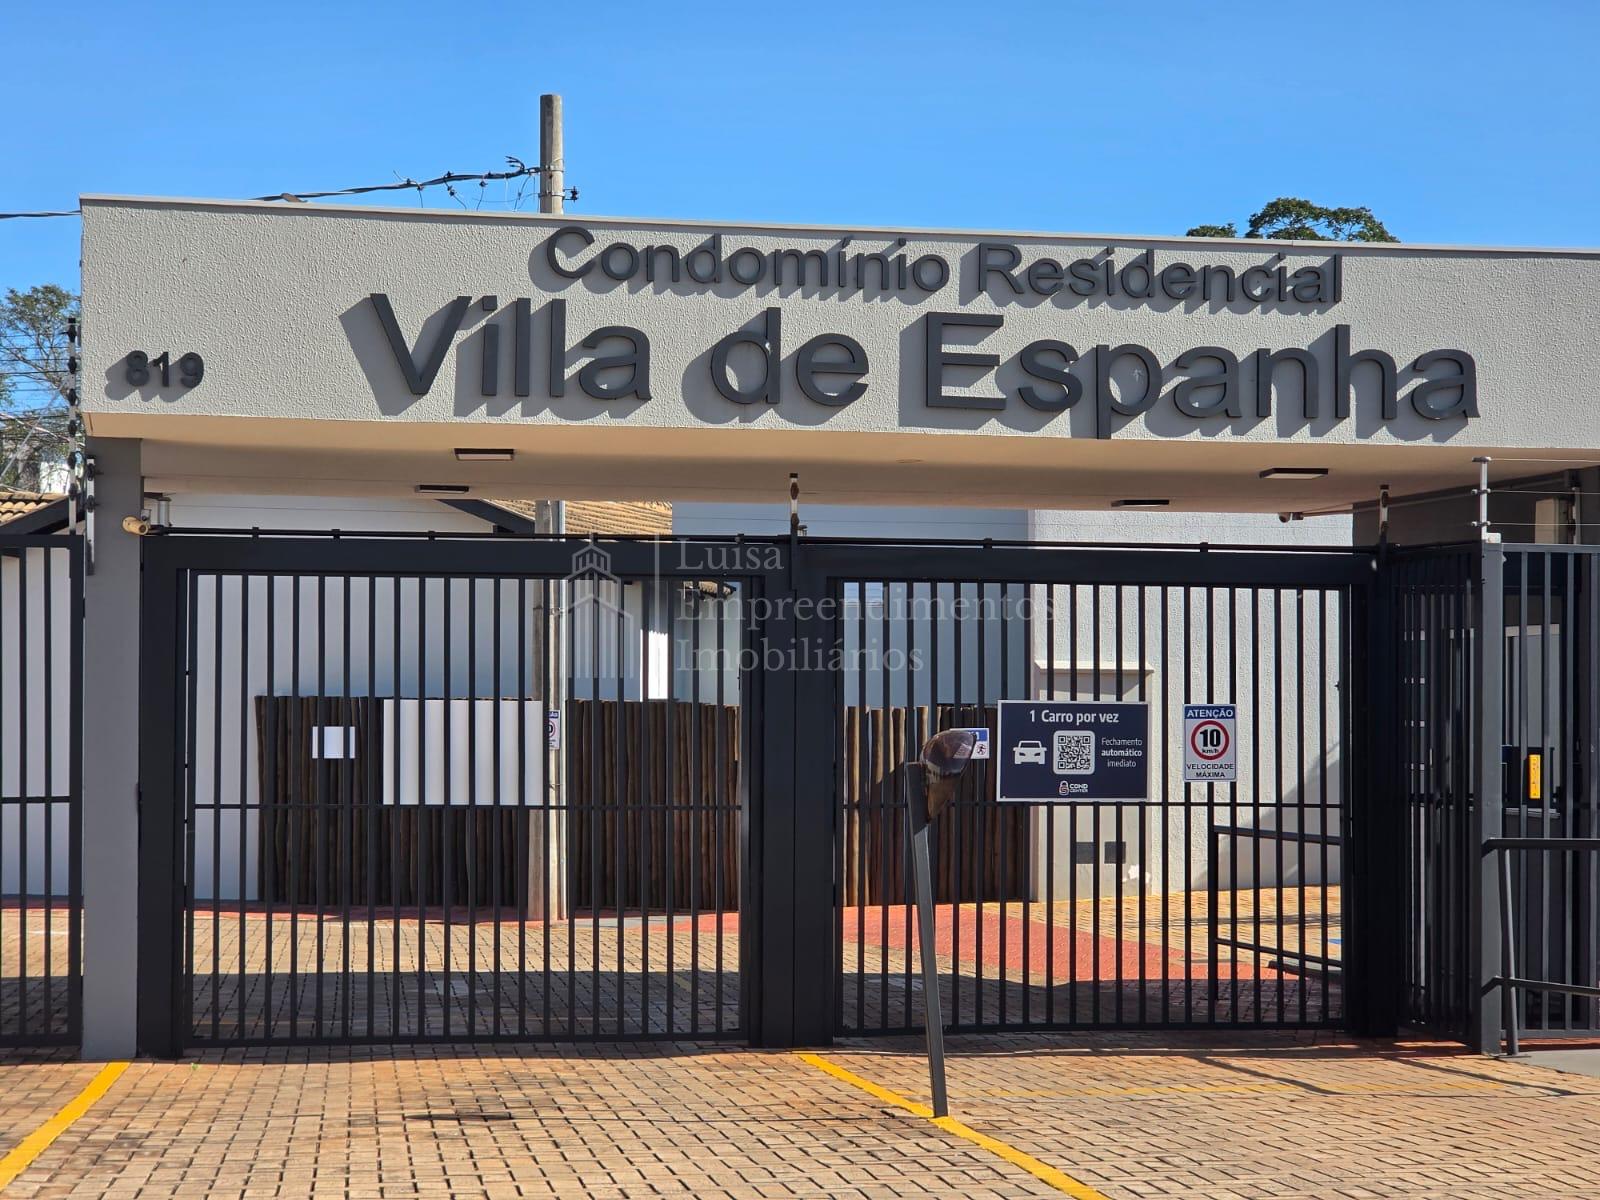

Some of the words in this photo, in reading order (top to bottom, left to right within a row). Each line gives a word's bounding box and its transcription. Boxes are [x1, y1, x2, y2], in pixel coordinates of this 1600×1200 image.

[547, 226, 950, 292] Condomínio
[978, 242, 1343, 302] Residencial
[125, 350, 204, 389] 819
[369, 293, 652, 401] Villa
[710, 306, 870, 406] de
[926, 311, 1481, 439] Espanha
[1029, 709, 1036, 723] 1
[1041, 709, 1074, 723] Carro
[1076, 712, 1096, 726] por
[1099, 712, 1120, 723] vez
[1186, 707, 1234, 719] ATENÇÃO
[1101, 737, 1143, 746] Fechamento
[1199, 728, 1221, 748] 10
[1101, 748, 1143, 757] automático
[1107, 759, 1137, 768] imediato
[1195, 770, 1226, 778] MÁXIMA
